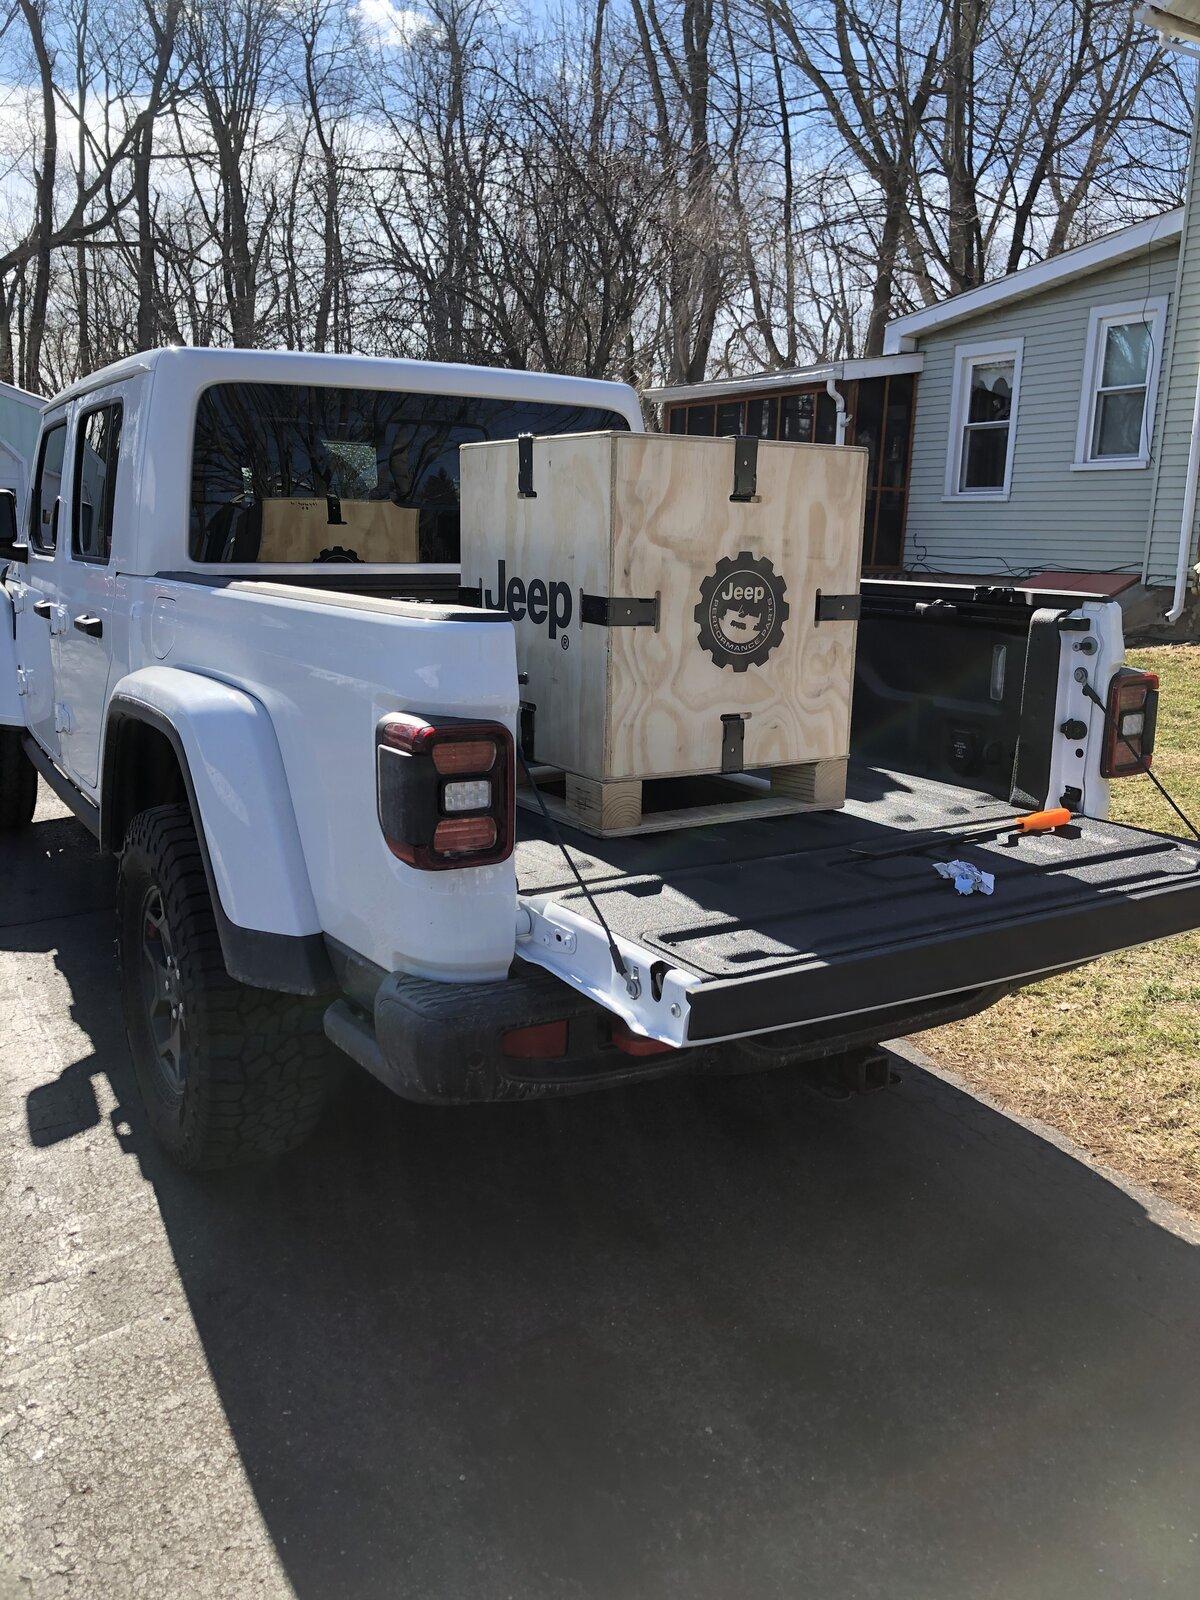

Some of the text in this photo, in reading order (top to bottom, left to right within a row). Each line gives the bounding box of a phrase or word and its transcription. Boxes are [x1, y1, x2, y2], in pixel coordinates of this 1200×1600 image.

[485, 560, 572, 640] Jeep
[721, 582, 765, 604] Jeep
[711, 597, 774, 652] PERFORMANCE PARTS
